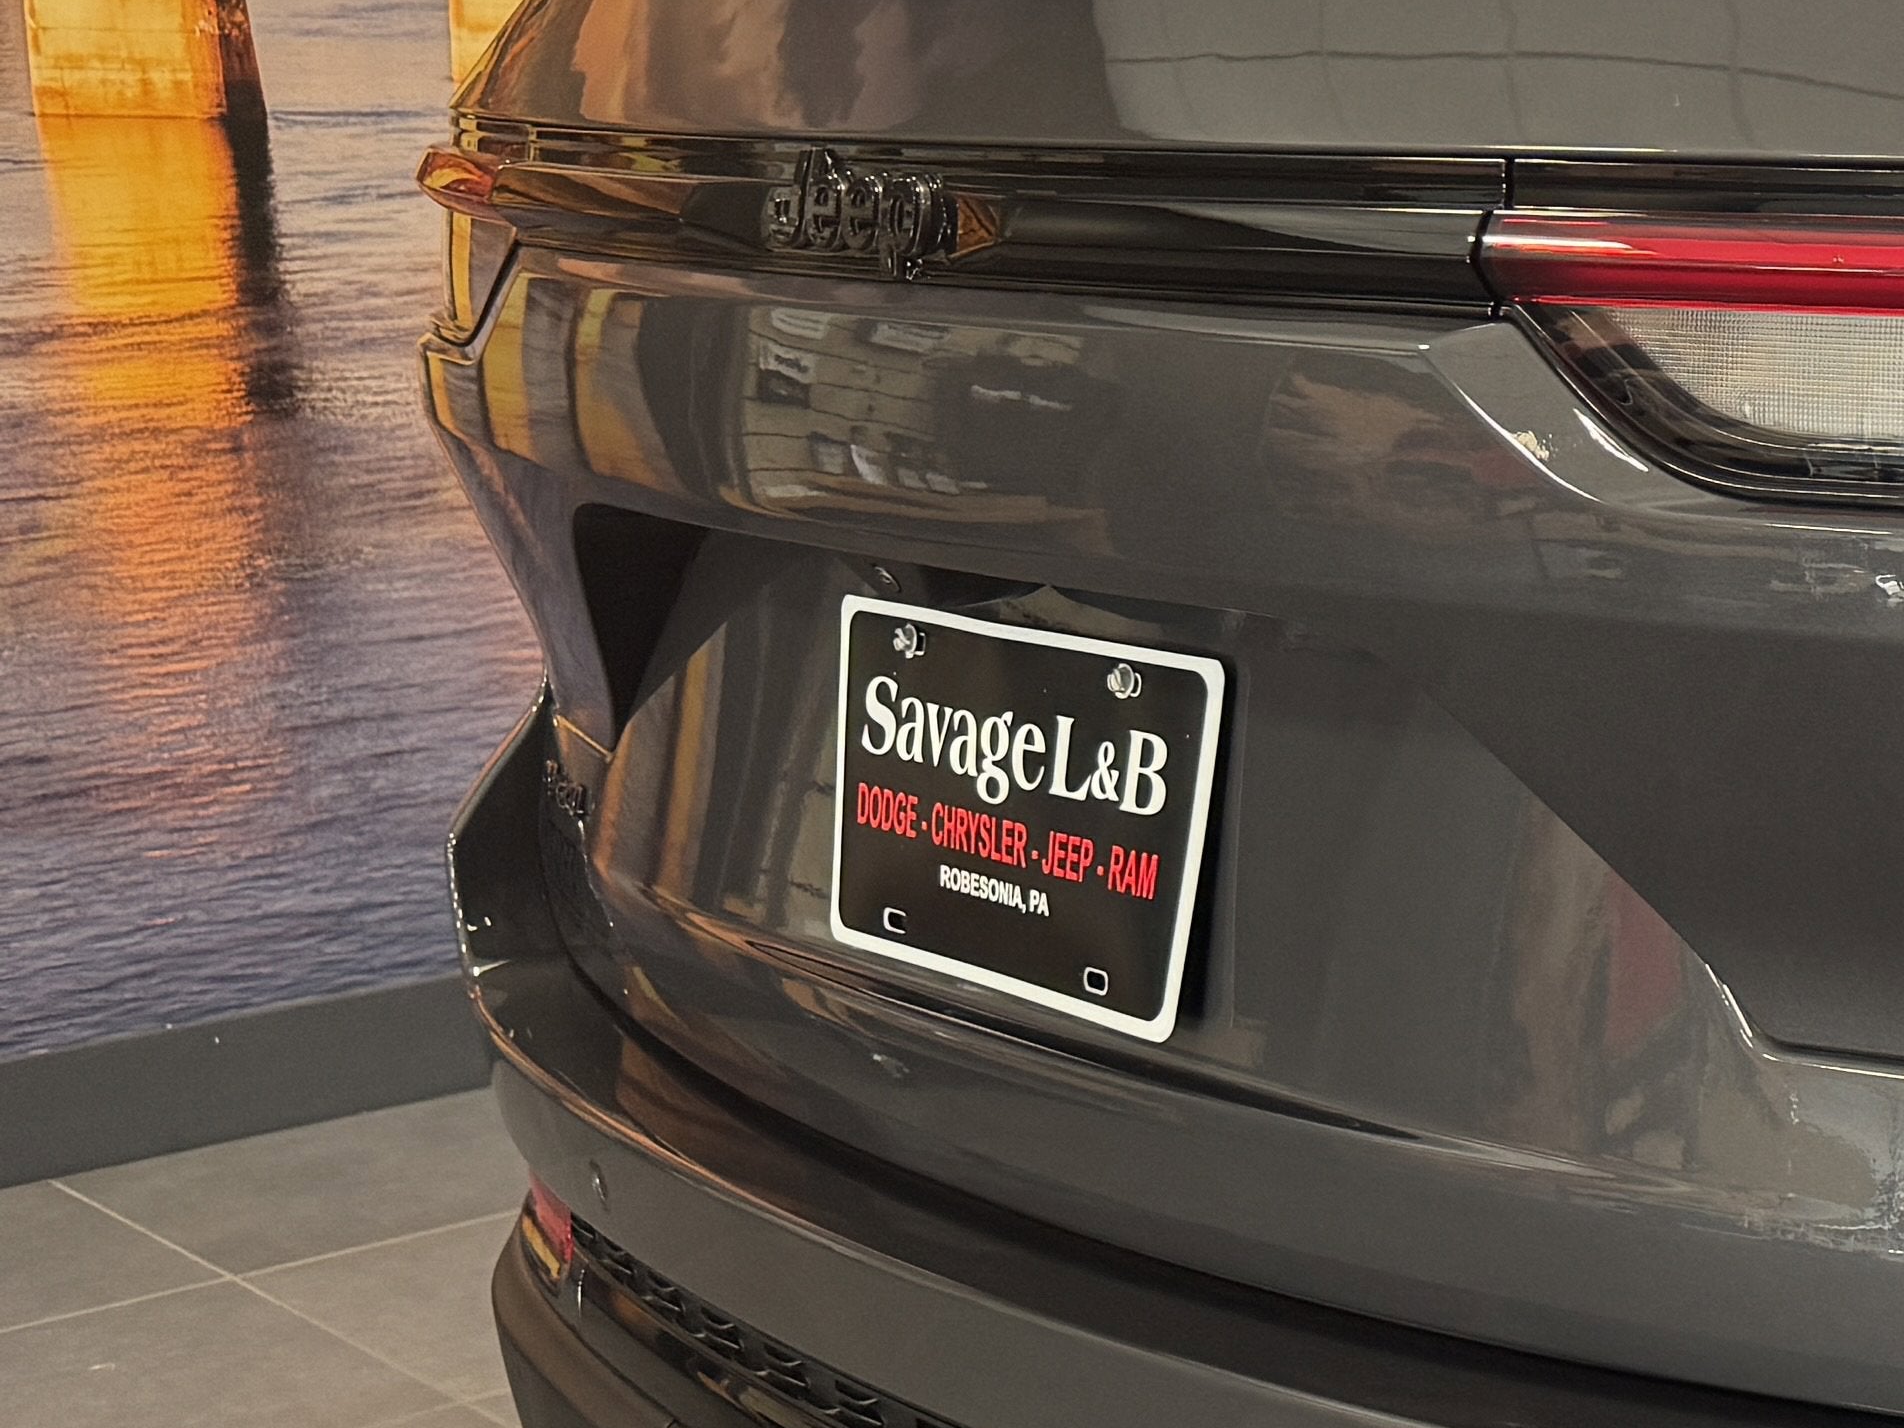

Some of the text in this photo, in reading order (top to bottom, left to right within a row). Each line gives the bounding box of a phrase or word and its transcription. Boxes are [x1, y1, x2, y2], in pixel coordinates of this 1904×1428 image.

[856, 783, 1159, 900] DODGE CHRYSLER JEEP RAM
[939, 864, 1050, 916] ROBESONIA, PA
